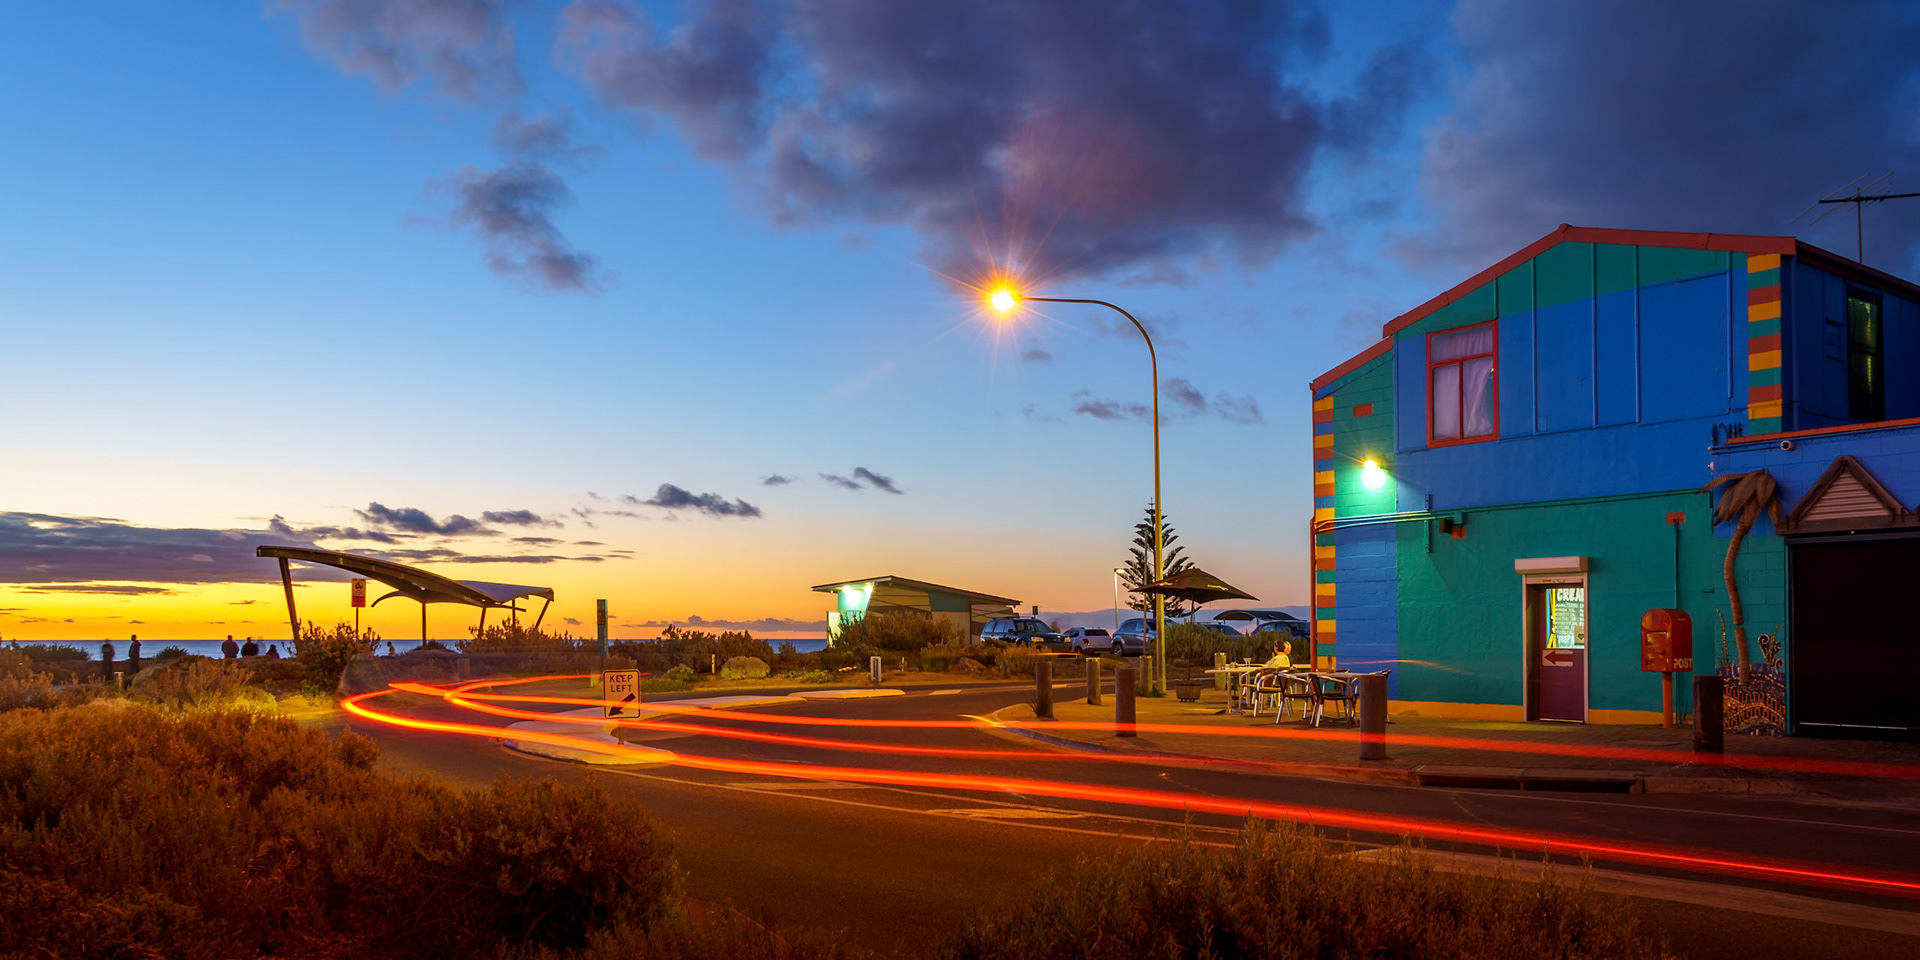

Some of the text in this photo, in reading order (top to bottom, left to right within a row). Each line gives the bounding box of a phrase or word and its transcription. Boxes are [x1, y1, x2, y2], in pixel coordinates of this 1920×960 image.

[1673, 658, 1693, 669] POST
[610, 675, 633, 683] KEEP
[610, 684, 632, 692] LEFT
